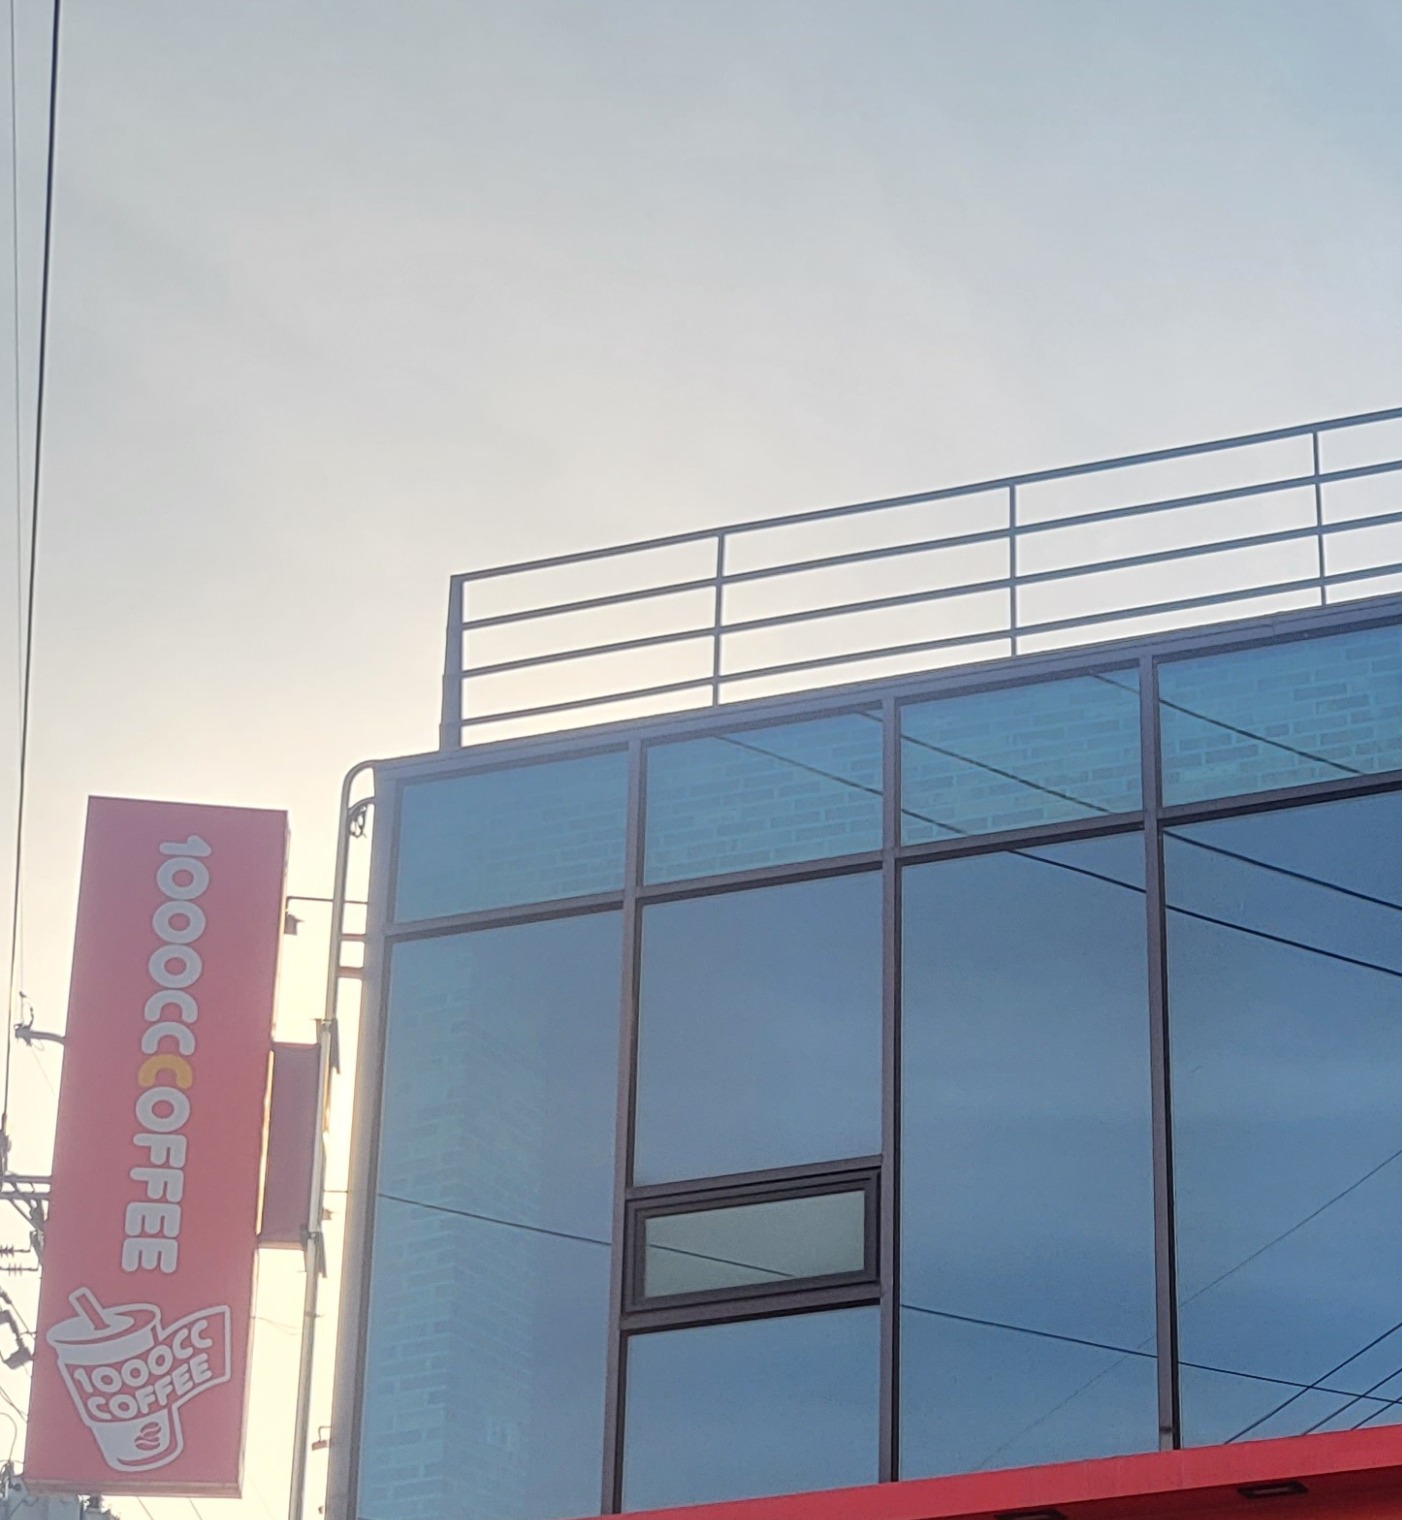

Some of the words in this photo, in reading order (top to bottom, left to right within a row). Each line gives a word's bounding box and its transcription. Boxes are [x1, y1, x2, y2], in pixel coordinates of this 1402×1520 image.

[121, 835, 212, 1274] 1000CCCOFFEE
[74, 1319, 215, 1395] 1000CC
[87, 1353, 213, 1422] COFFEE
